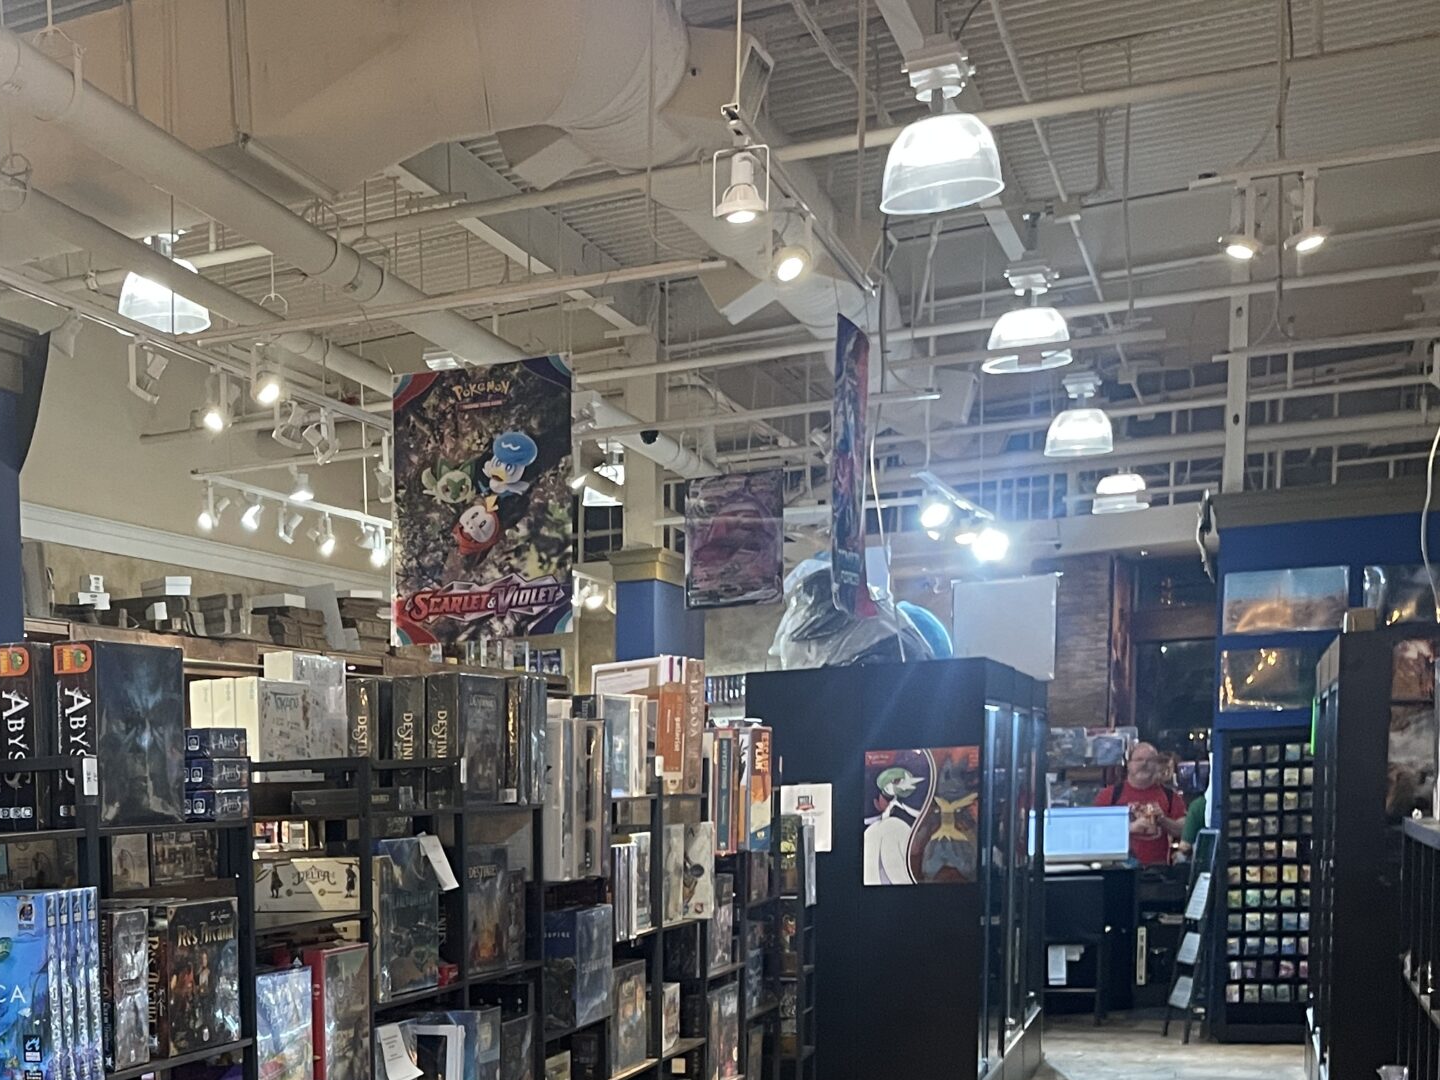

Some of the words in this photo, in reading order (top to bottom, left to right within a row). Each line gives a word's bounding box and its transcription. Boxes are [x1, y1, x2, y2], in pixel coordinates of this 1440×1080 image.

[411, 592, 489, 620] SCARLET
[494, 585, 561, 614] VIOLET
[177, 925, 198, 947] Res
